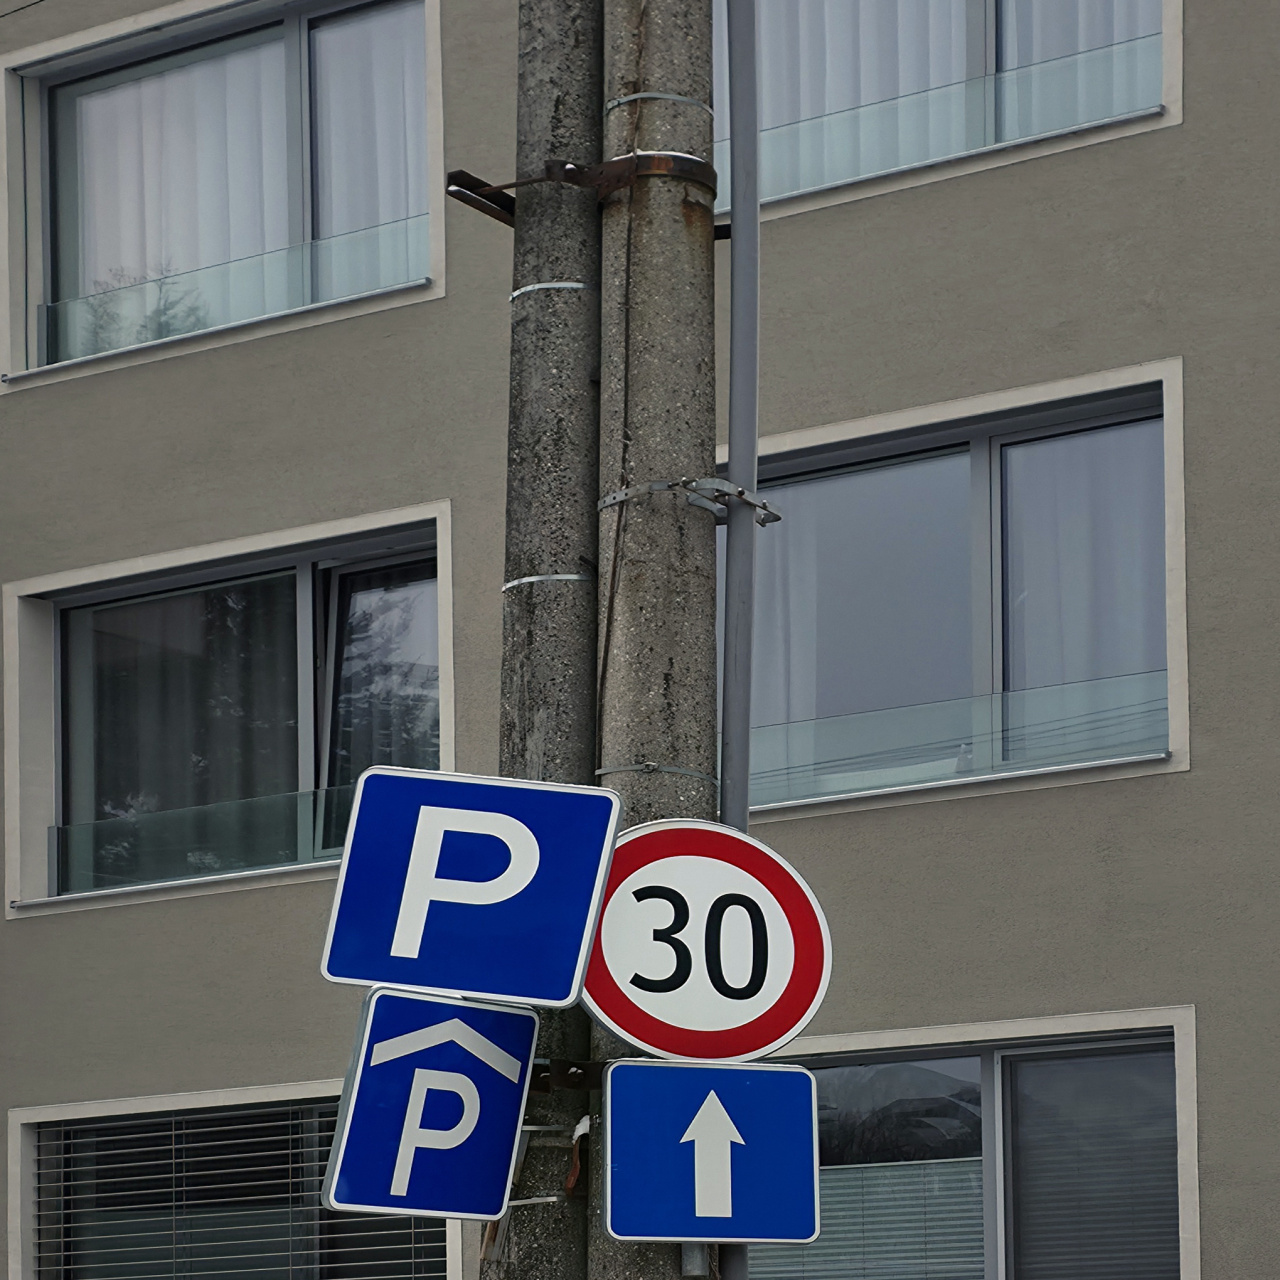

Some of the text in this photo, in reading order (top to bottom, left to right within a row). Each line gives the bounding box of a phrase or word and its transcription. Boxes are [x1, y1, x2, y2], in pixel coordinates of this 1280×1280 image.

[389, 804, 541, 959] P
[628, 885, 770, 1000] 30
[389, 1067, 481, 1197] P
